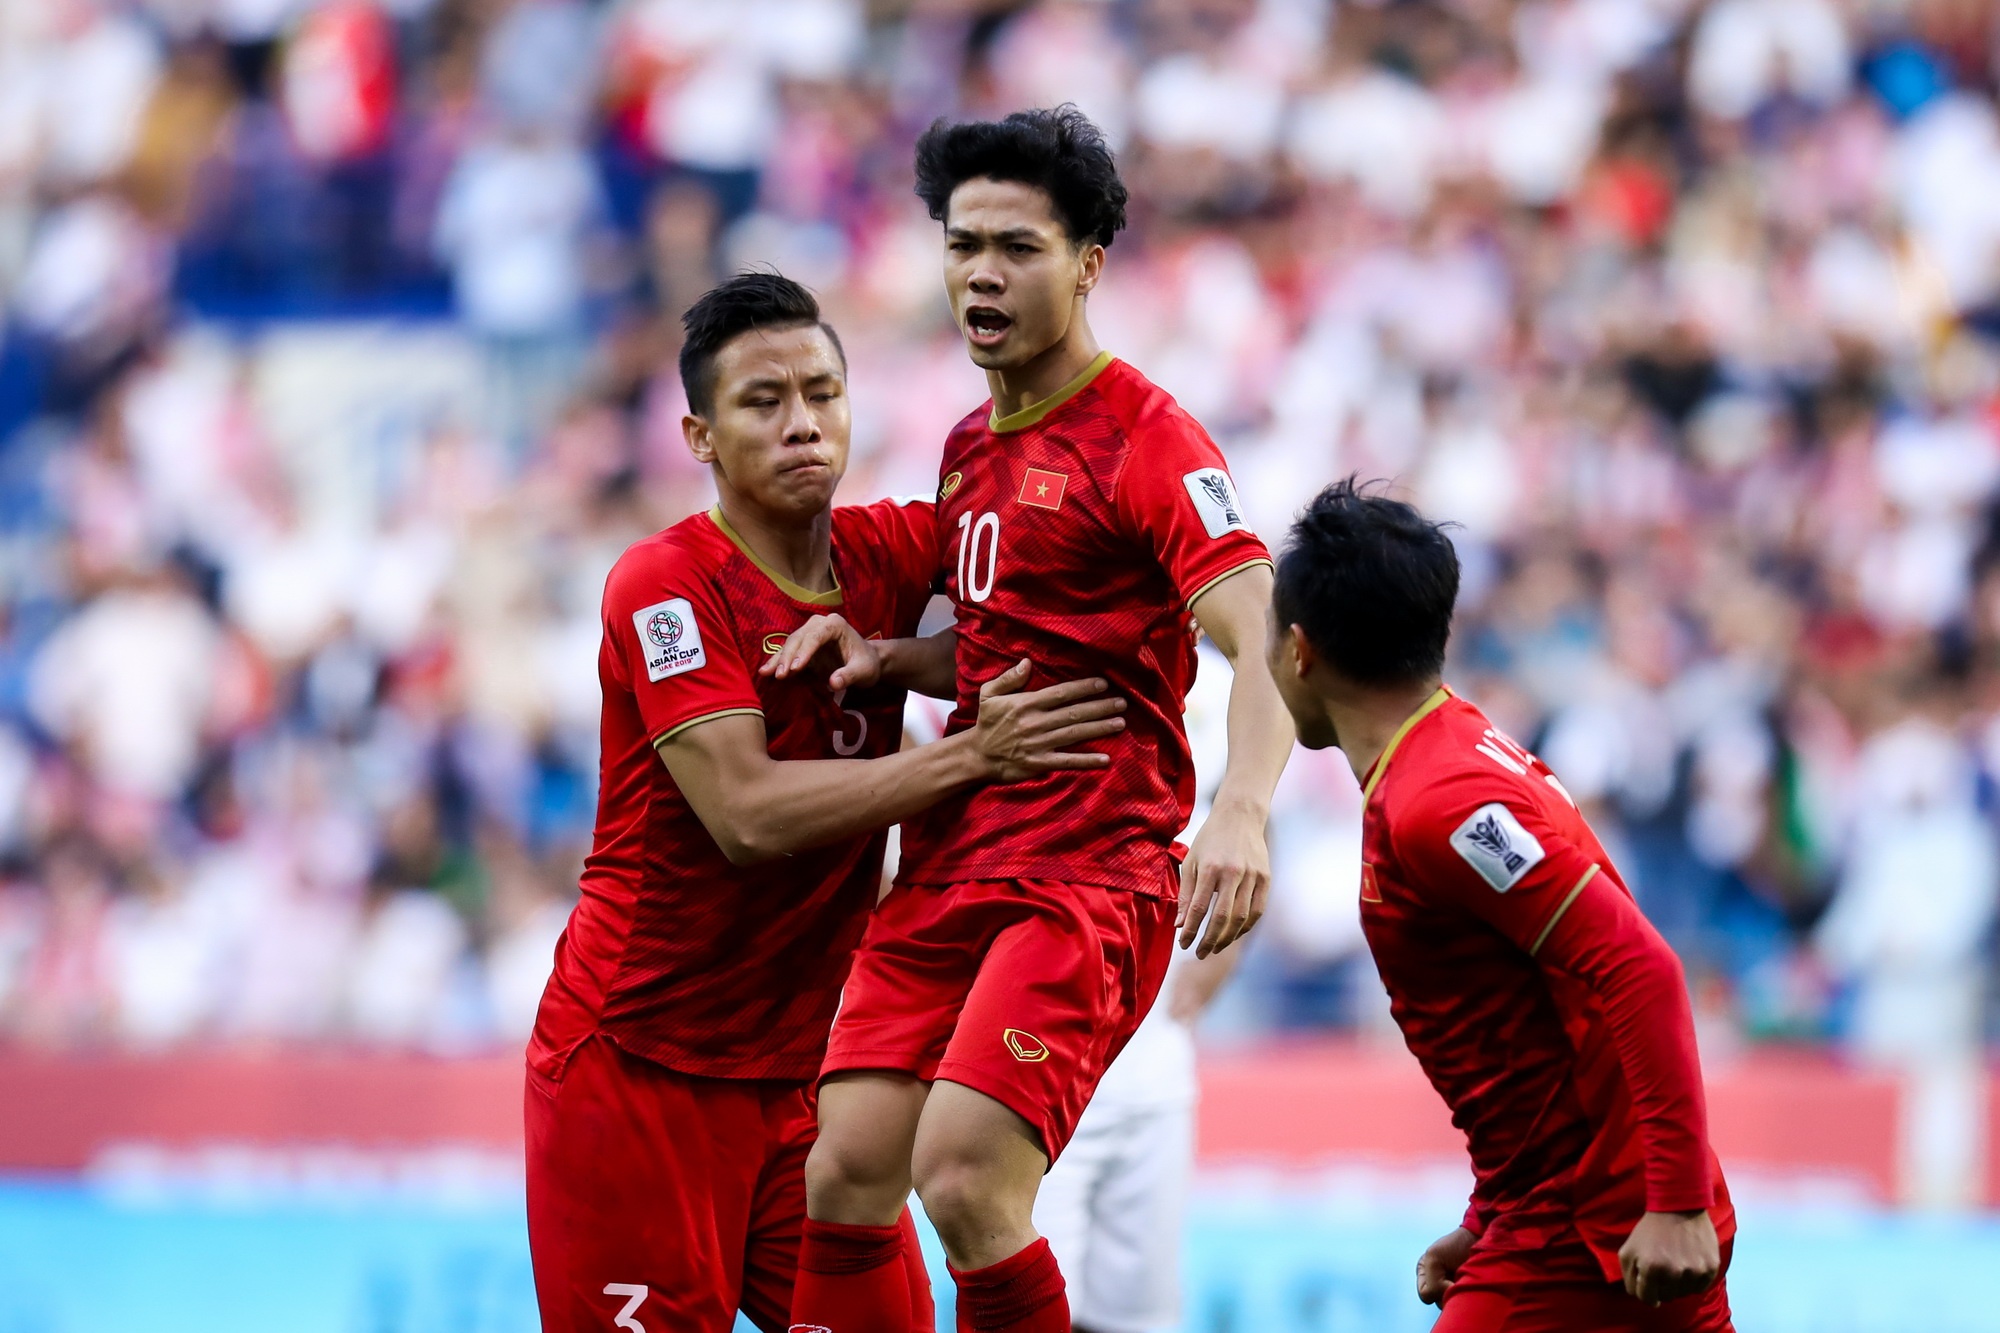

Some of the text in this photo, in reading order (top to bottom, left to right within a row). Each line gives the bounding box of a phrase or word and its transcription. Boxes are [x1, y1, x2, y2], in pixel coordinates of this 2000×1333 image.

[958, 510, 999, 602] 10
[650, 647, 700, 669] ASIAN CUP
[663, 645, 679, 655] AFC
[659, 663, 673, 671] UAE
